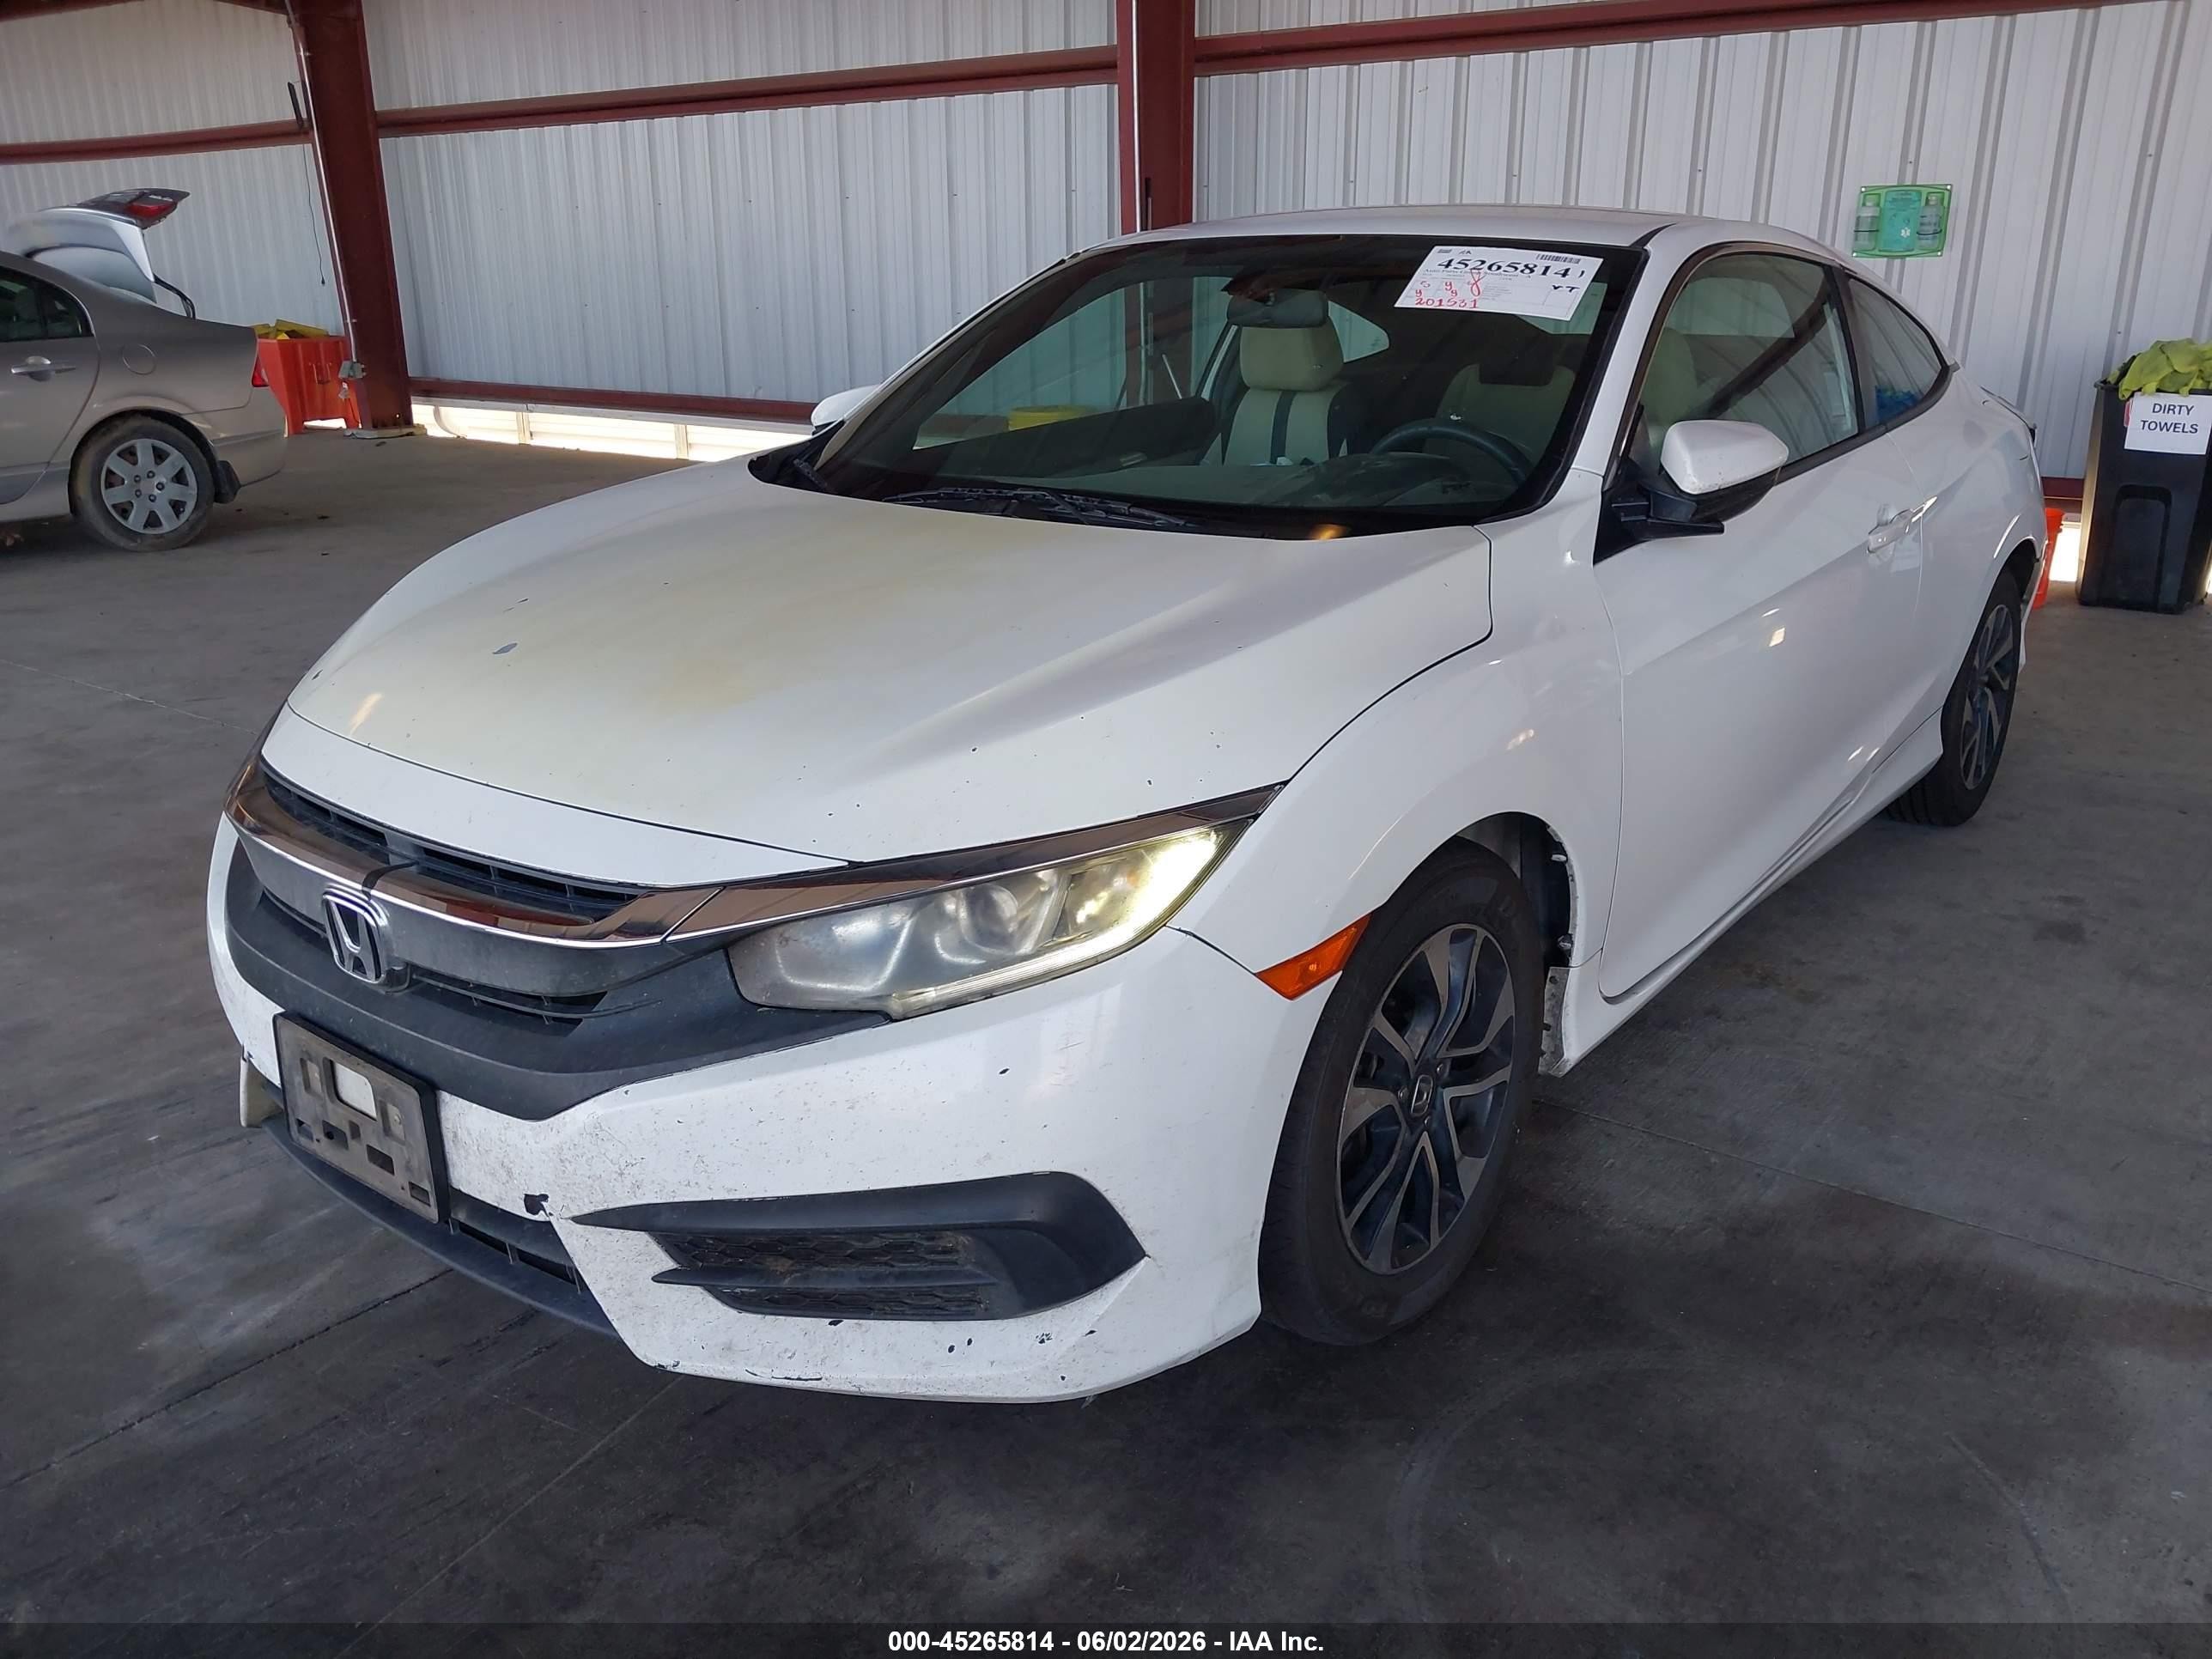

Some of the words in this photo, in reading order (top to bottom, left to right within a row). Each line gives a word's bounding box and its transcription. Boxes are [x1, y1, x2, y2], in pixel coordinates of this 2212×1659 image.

[1437, 258, 1571, 278] 45265814
[2152, 403, 2195, 416] DIRTY
[2141, 420, 2199, 434] TOWELS
